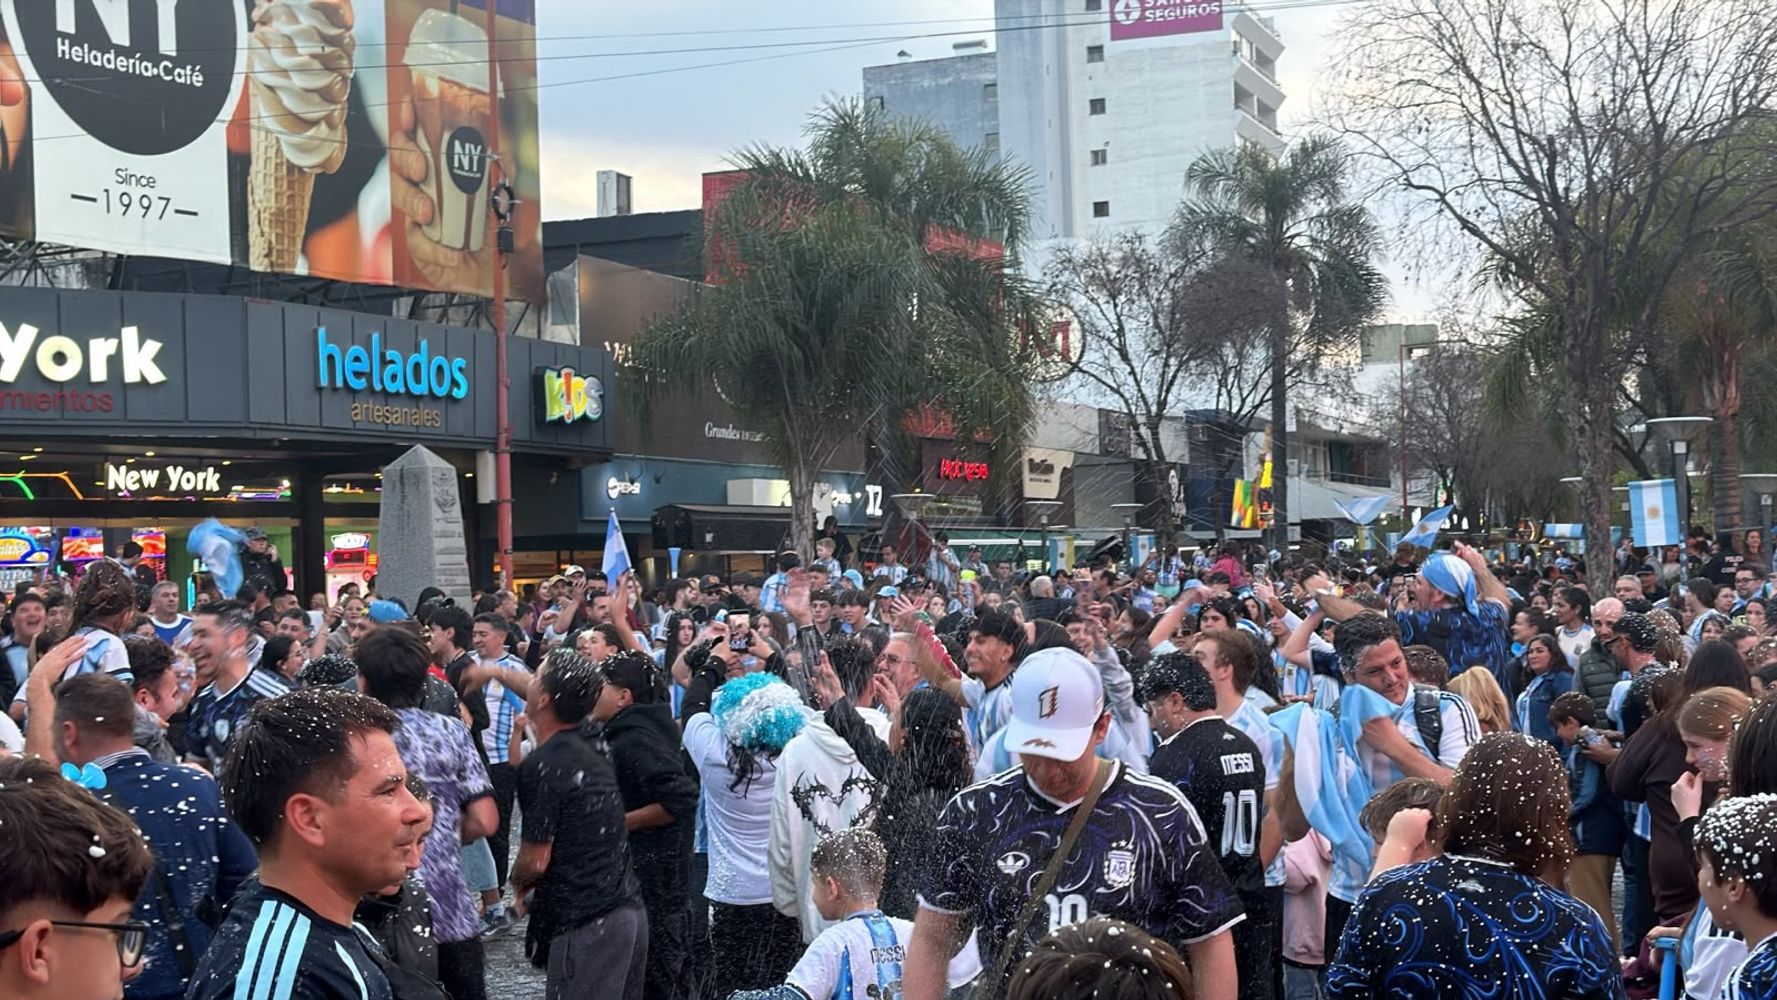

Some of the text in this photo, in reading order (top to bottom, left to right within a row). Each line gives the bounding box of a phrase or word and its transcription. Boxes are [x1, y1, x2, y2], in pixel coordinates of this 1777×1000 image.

[1145, 2, 1220, 22] SEGUROS
[454, 140, 482, 172] NY
[115, 168, 156, 189] Since
[316, 326, 468, 400] helados
[351, 400, 441, 428] artesanales
[107, 464, 220, 492] New York
[1220, 752, 1255, 775] MESSI
[1221, 789, 1257, 858] 10
[1045, 893, 1088, 933] 10
